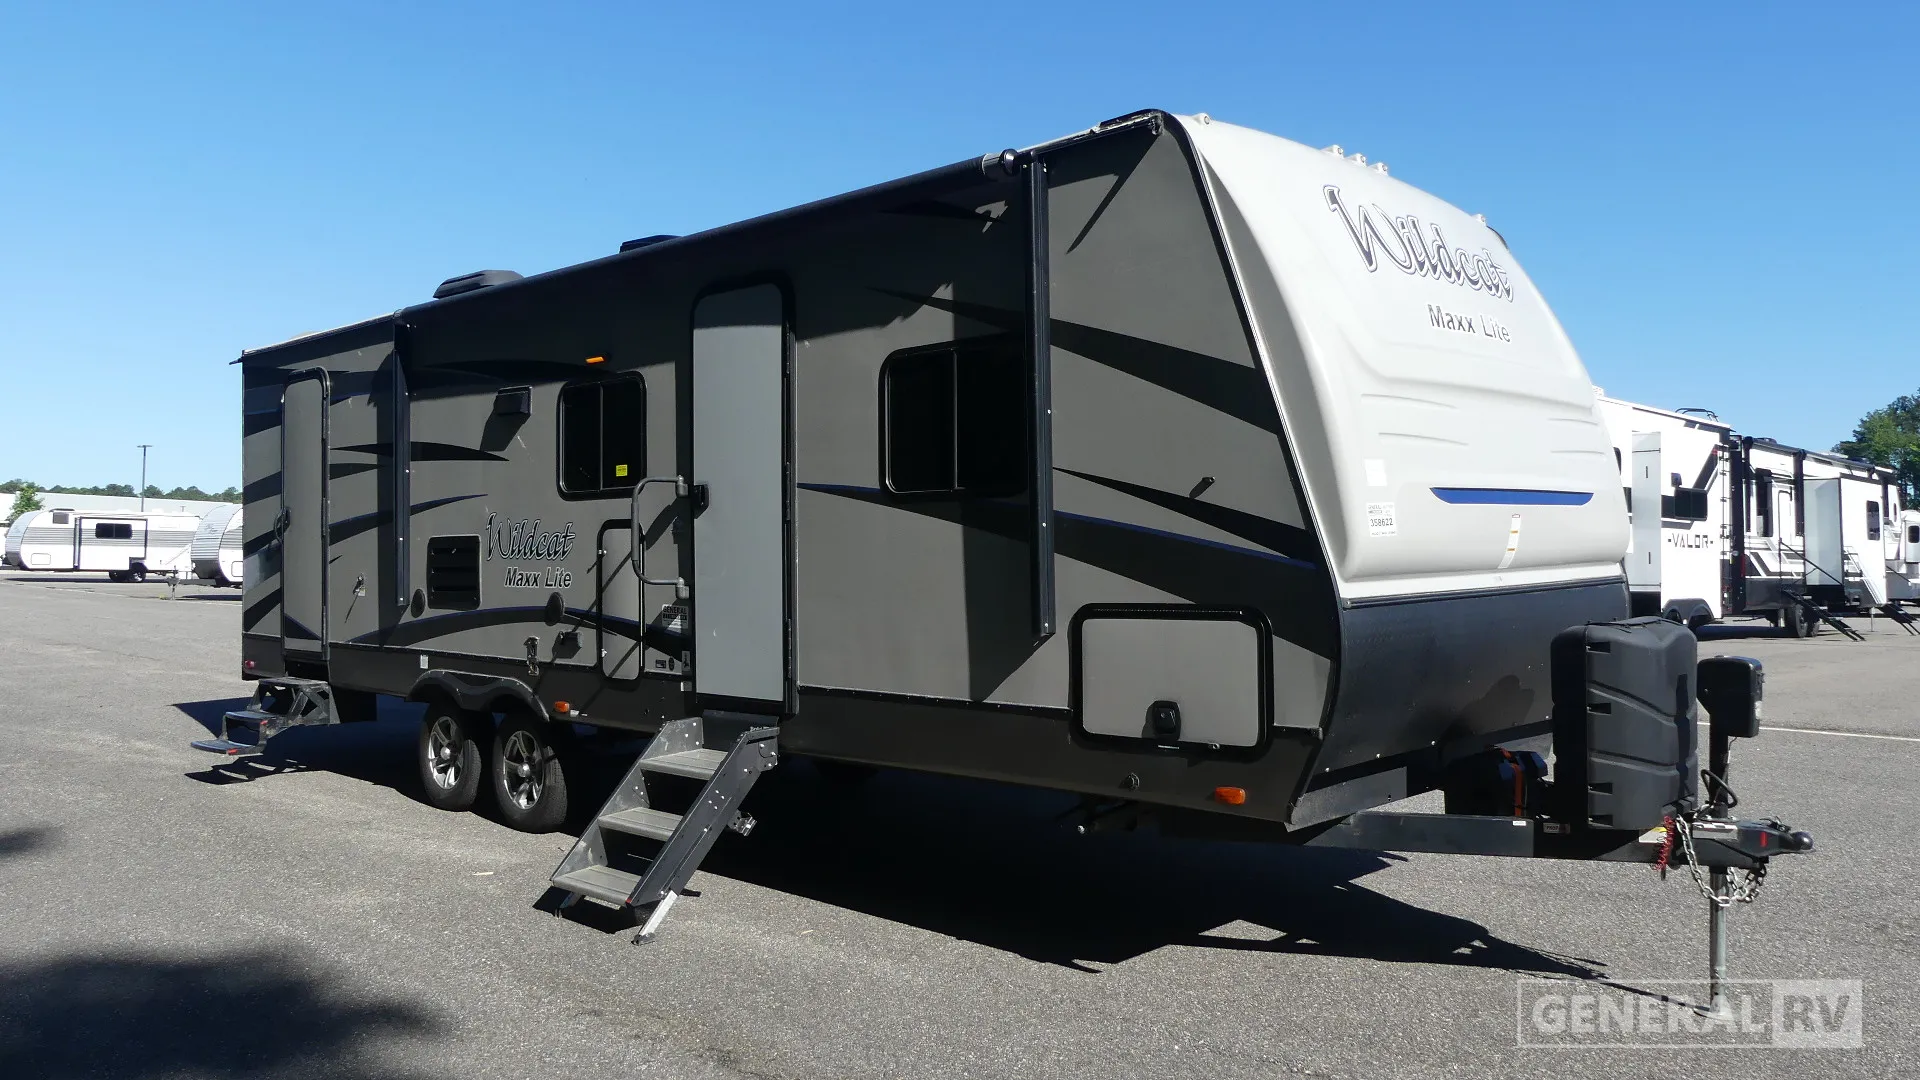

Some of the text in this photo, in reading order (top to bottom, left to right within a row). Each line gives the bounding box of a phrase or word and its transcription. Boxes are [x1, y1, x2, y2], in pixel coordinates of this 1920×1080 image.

[1323, 185, 1514, 303] Wildcat
[1427, 304, 1511, 343] Maxx Lite
[486, 511, 576, 561] Wildcat
[1370, 517, 1394, 527] 358622
[504, 566, 572, 588] Maxx Lite
